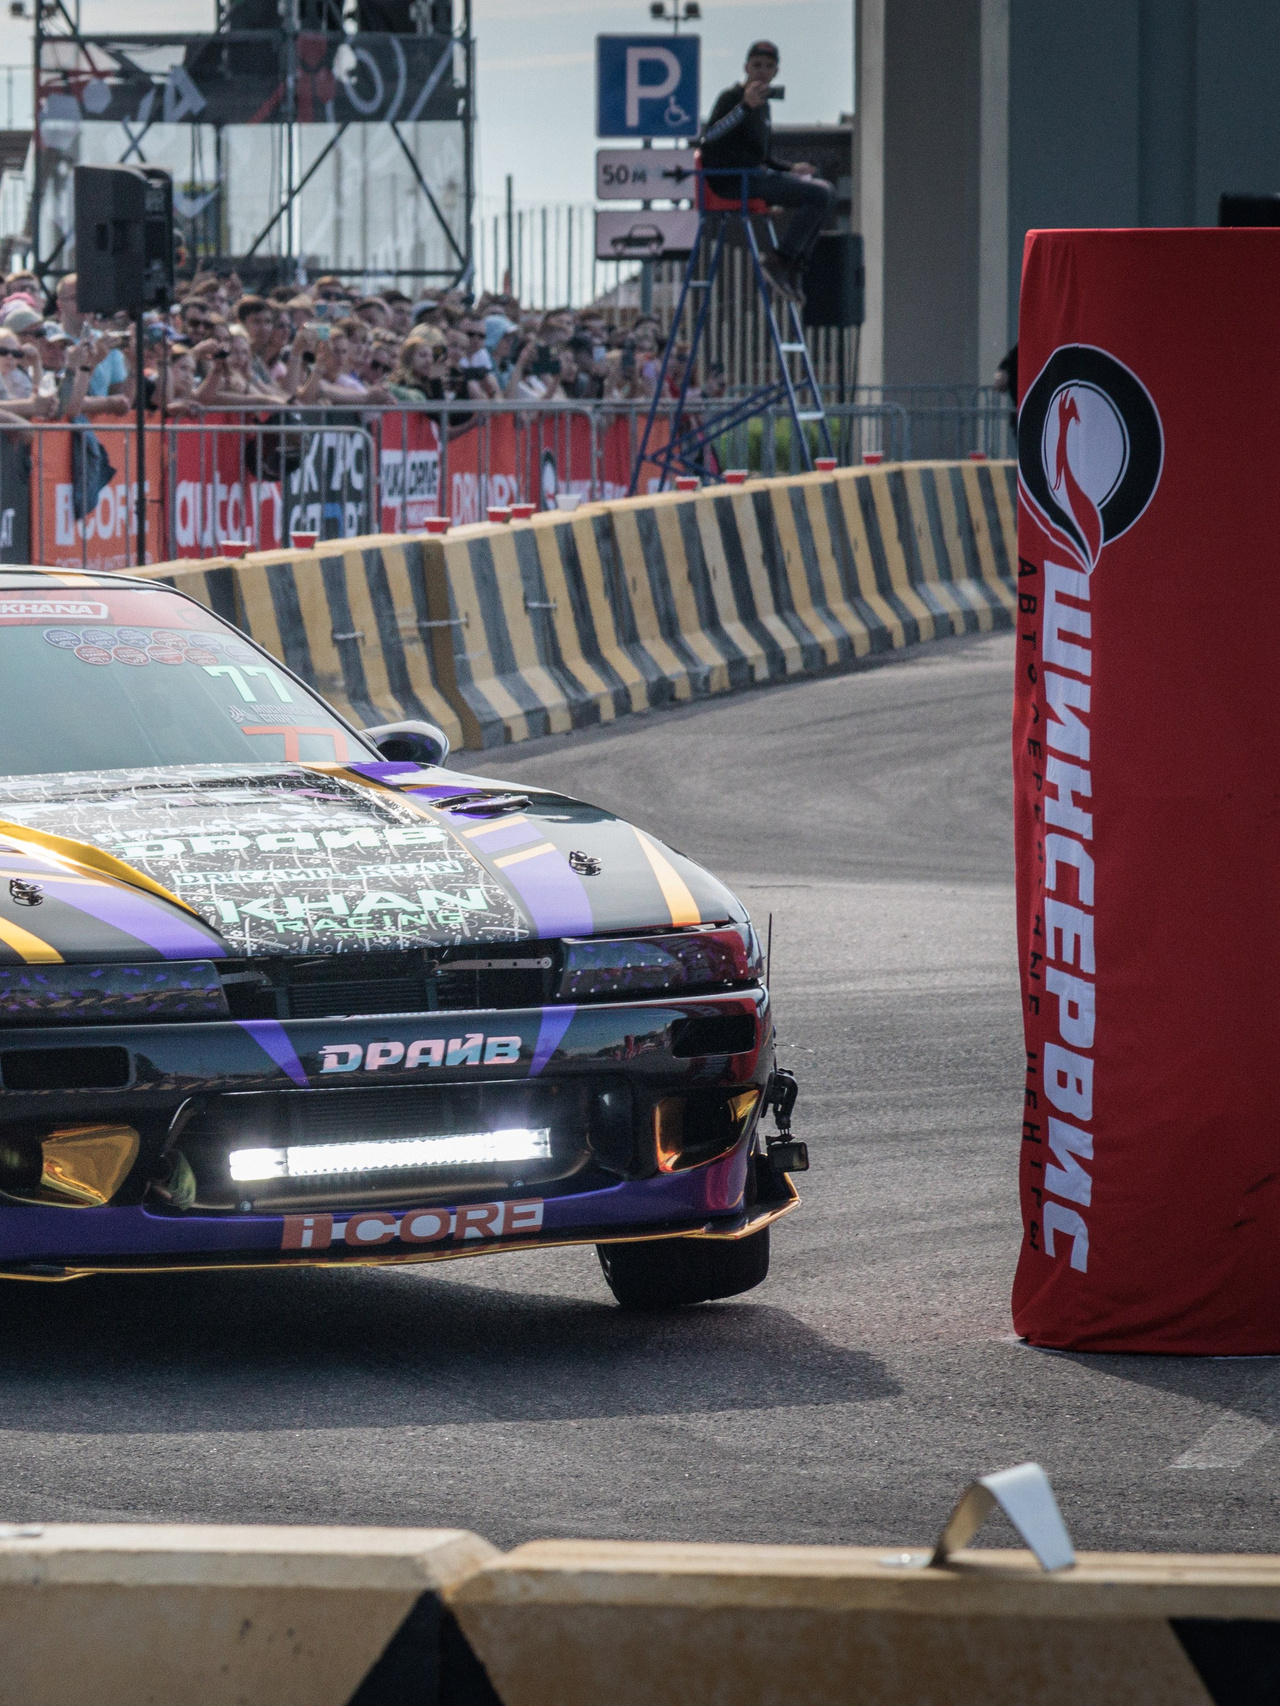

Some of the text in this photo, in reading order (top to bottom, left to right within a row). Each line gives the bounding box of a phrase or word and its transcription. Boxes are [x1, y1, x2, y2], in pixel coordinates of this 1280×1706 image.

[625, 46, 681, 127] P
[602, 164, 629, 185] 50
[202, 666, 293, 703] 77
[206, 888, 488, 923] KHAN
[274, 912, 466, 935] RACING
[1042, 560, 1096, 1274] ШИНСЕРВИС
